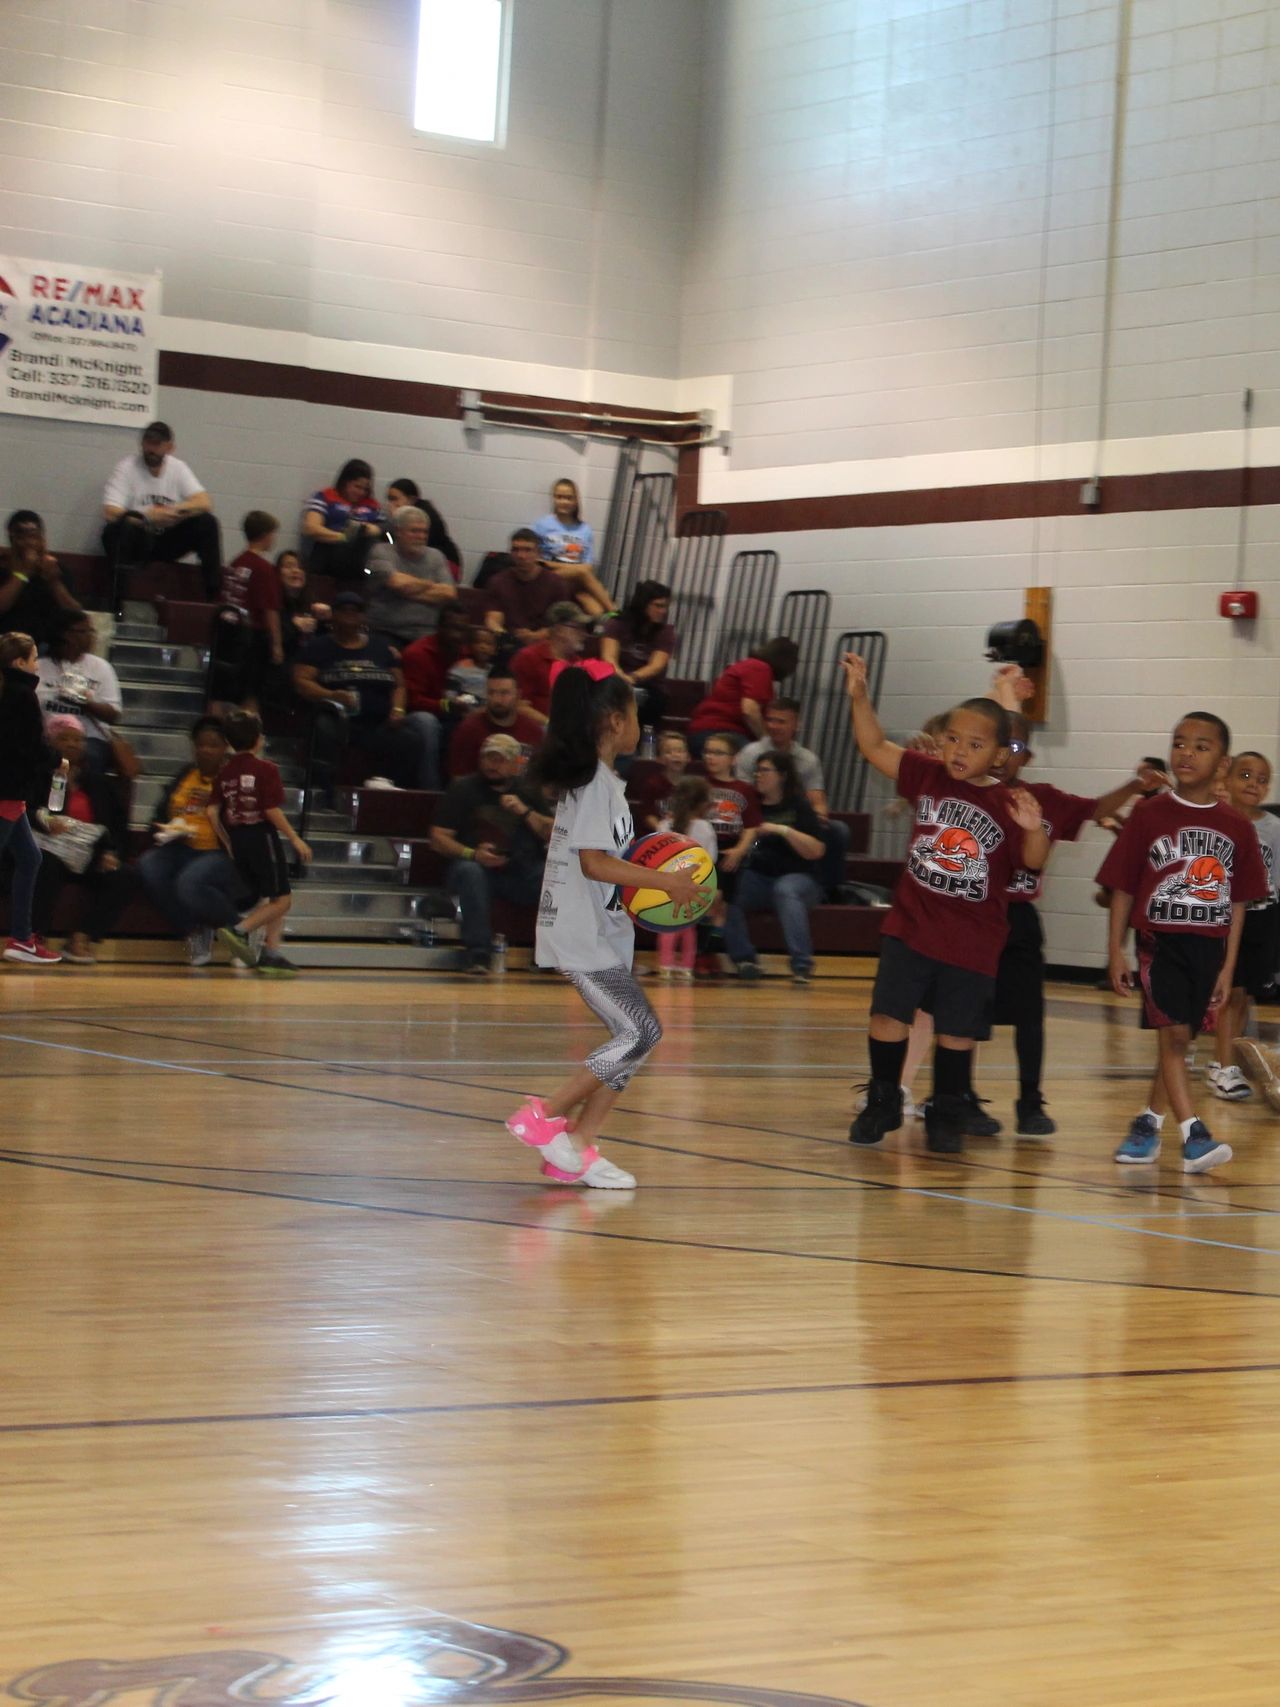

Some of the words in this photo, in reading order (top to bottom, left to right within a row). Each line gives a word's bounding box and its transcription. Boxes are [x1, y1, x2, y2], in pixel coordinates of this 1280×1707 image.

[31, 274, 145, 312] RE/MAX
[27, 304, 146, 338] ACADIANA
[9, 349, 63, 368] Brandi
[935, 799, 1002, 852] ATHLETICS
